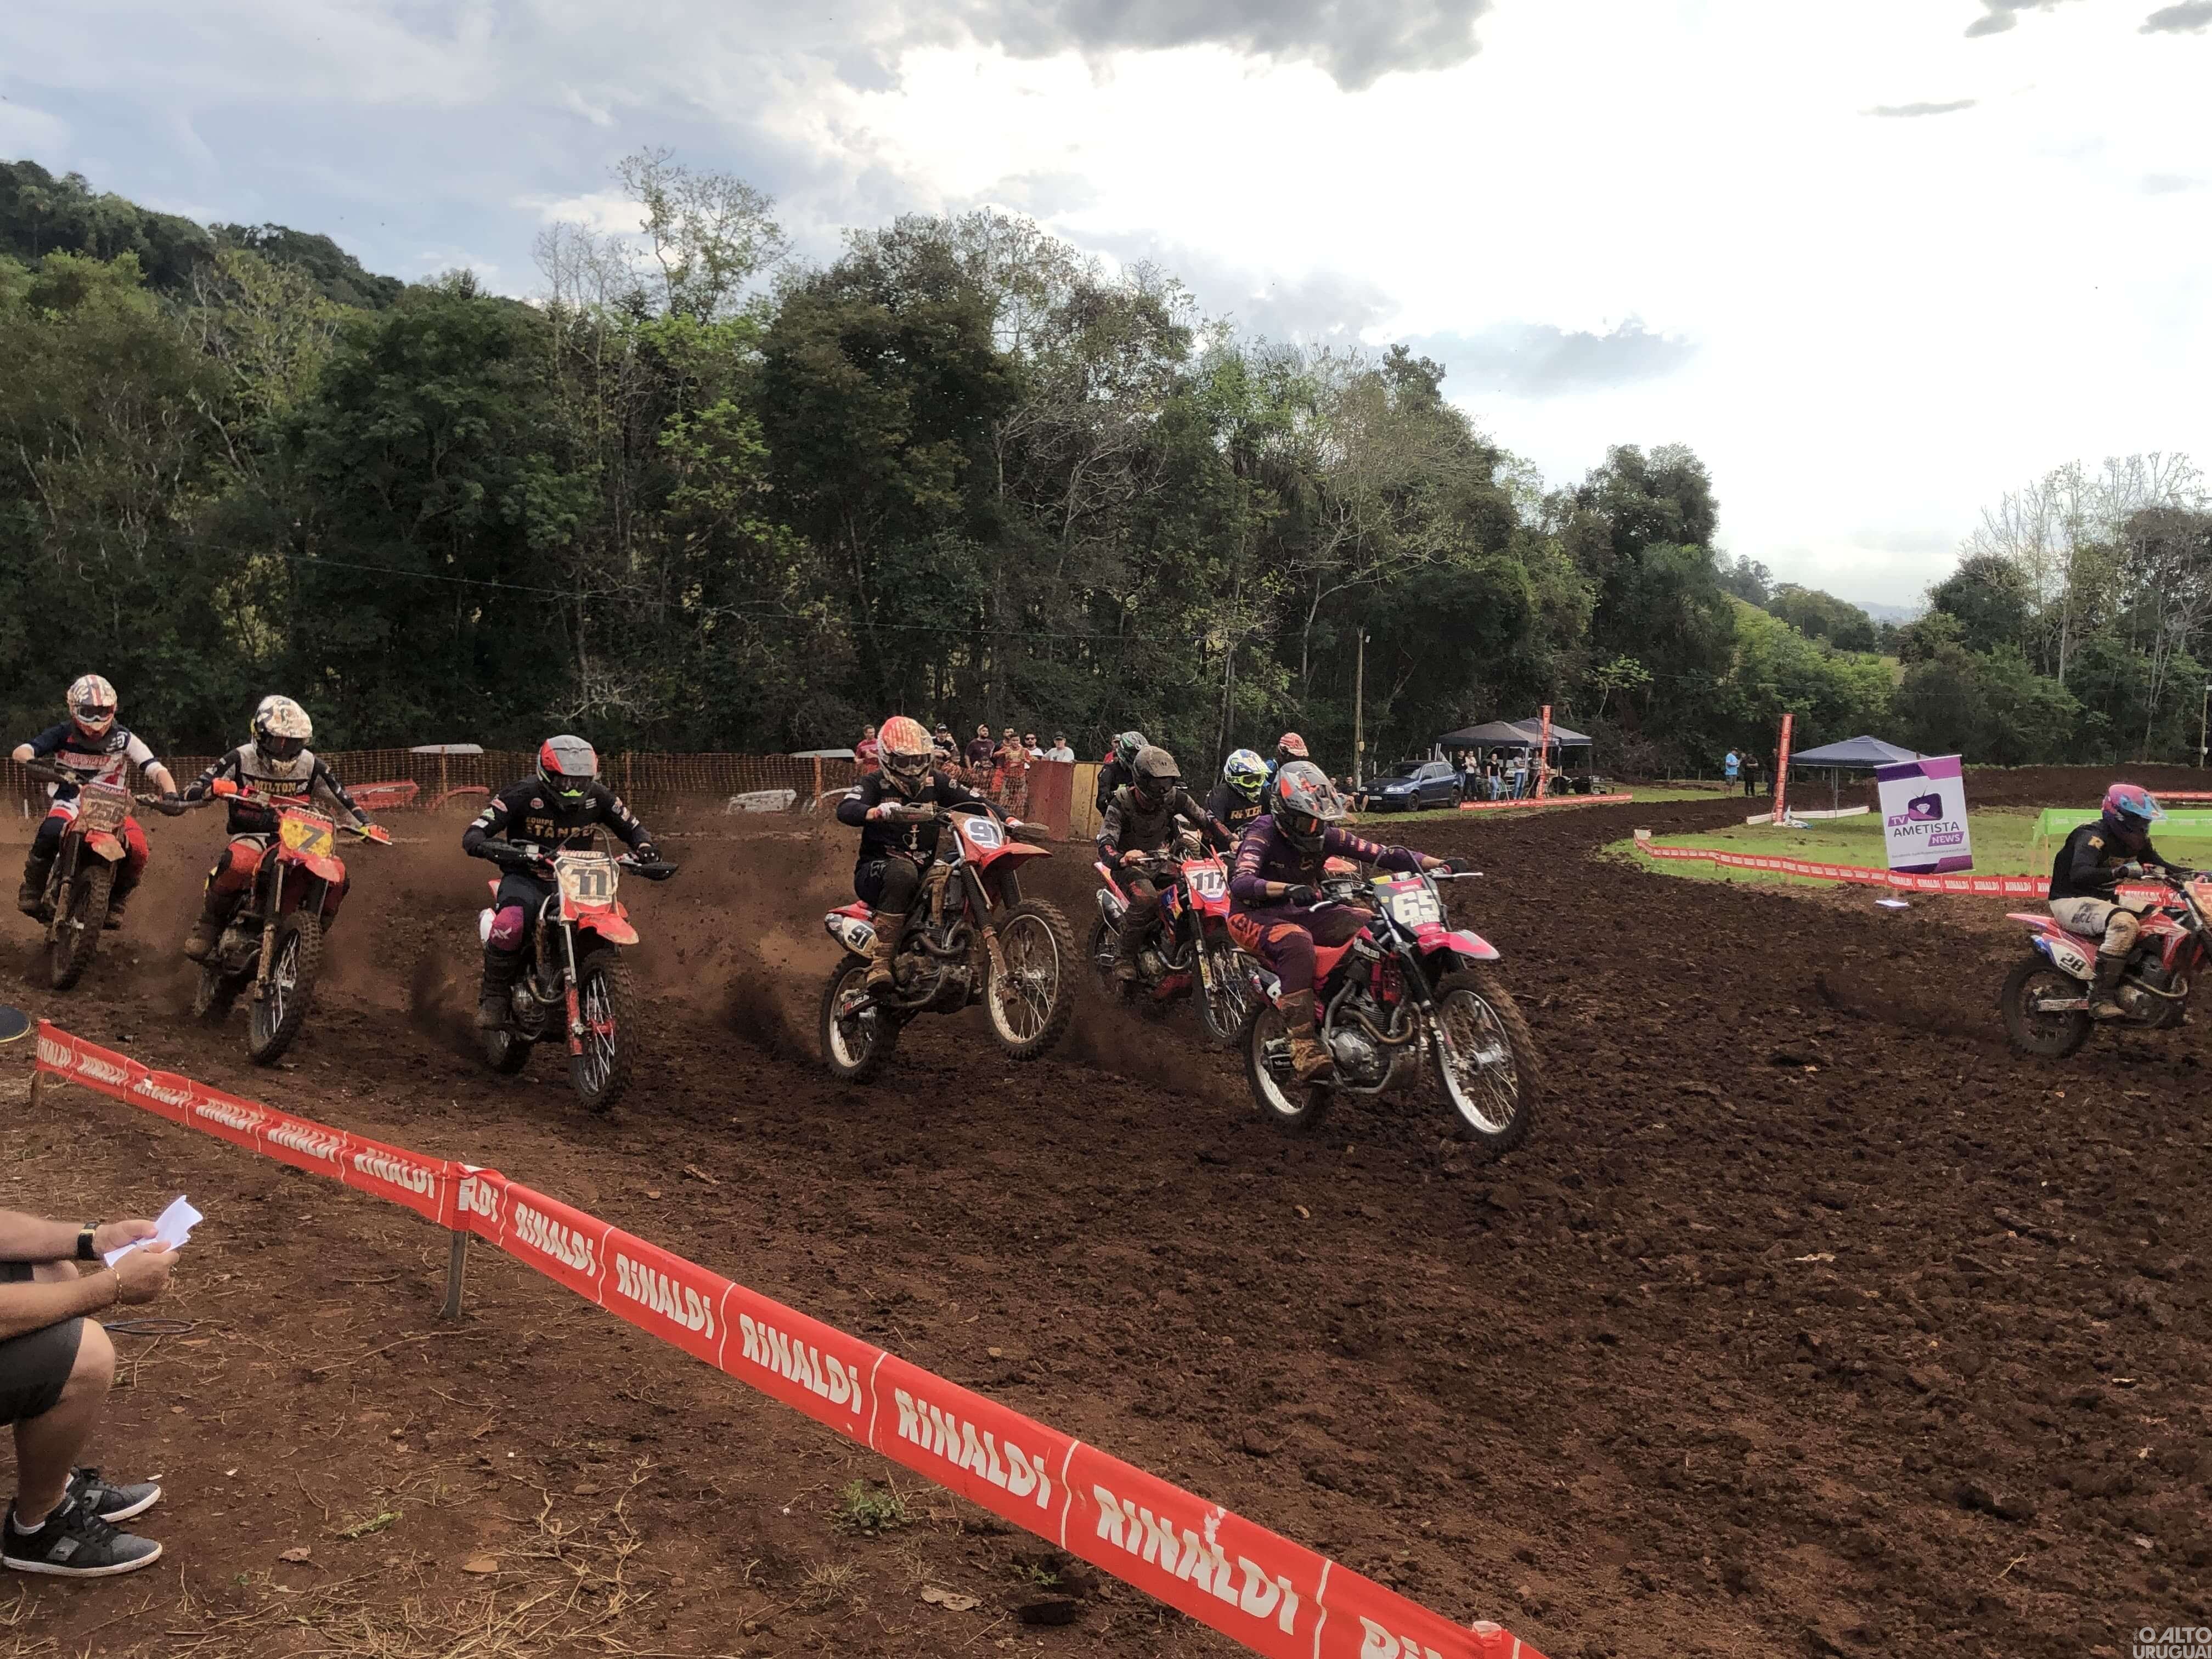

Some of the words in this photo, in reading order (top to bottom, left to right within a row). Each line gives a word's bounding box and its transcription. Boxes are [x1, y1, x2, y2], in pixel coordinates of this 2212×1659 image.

[1891, 816, 1906, 825] TV
[1894, 821, 1960, 837] AMETISTA
[296, 825, 325, 852] 7
[969, 821, 999, 844] 91
[1932, 834, 1961, 844] NEWS
[571, 868, 606, 896] 11
[1192, 872, 1224, 890] 117
[1392, 889, 1440, 924] 65
[2060, 953, 2086, 972] 28
